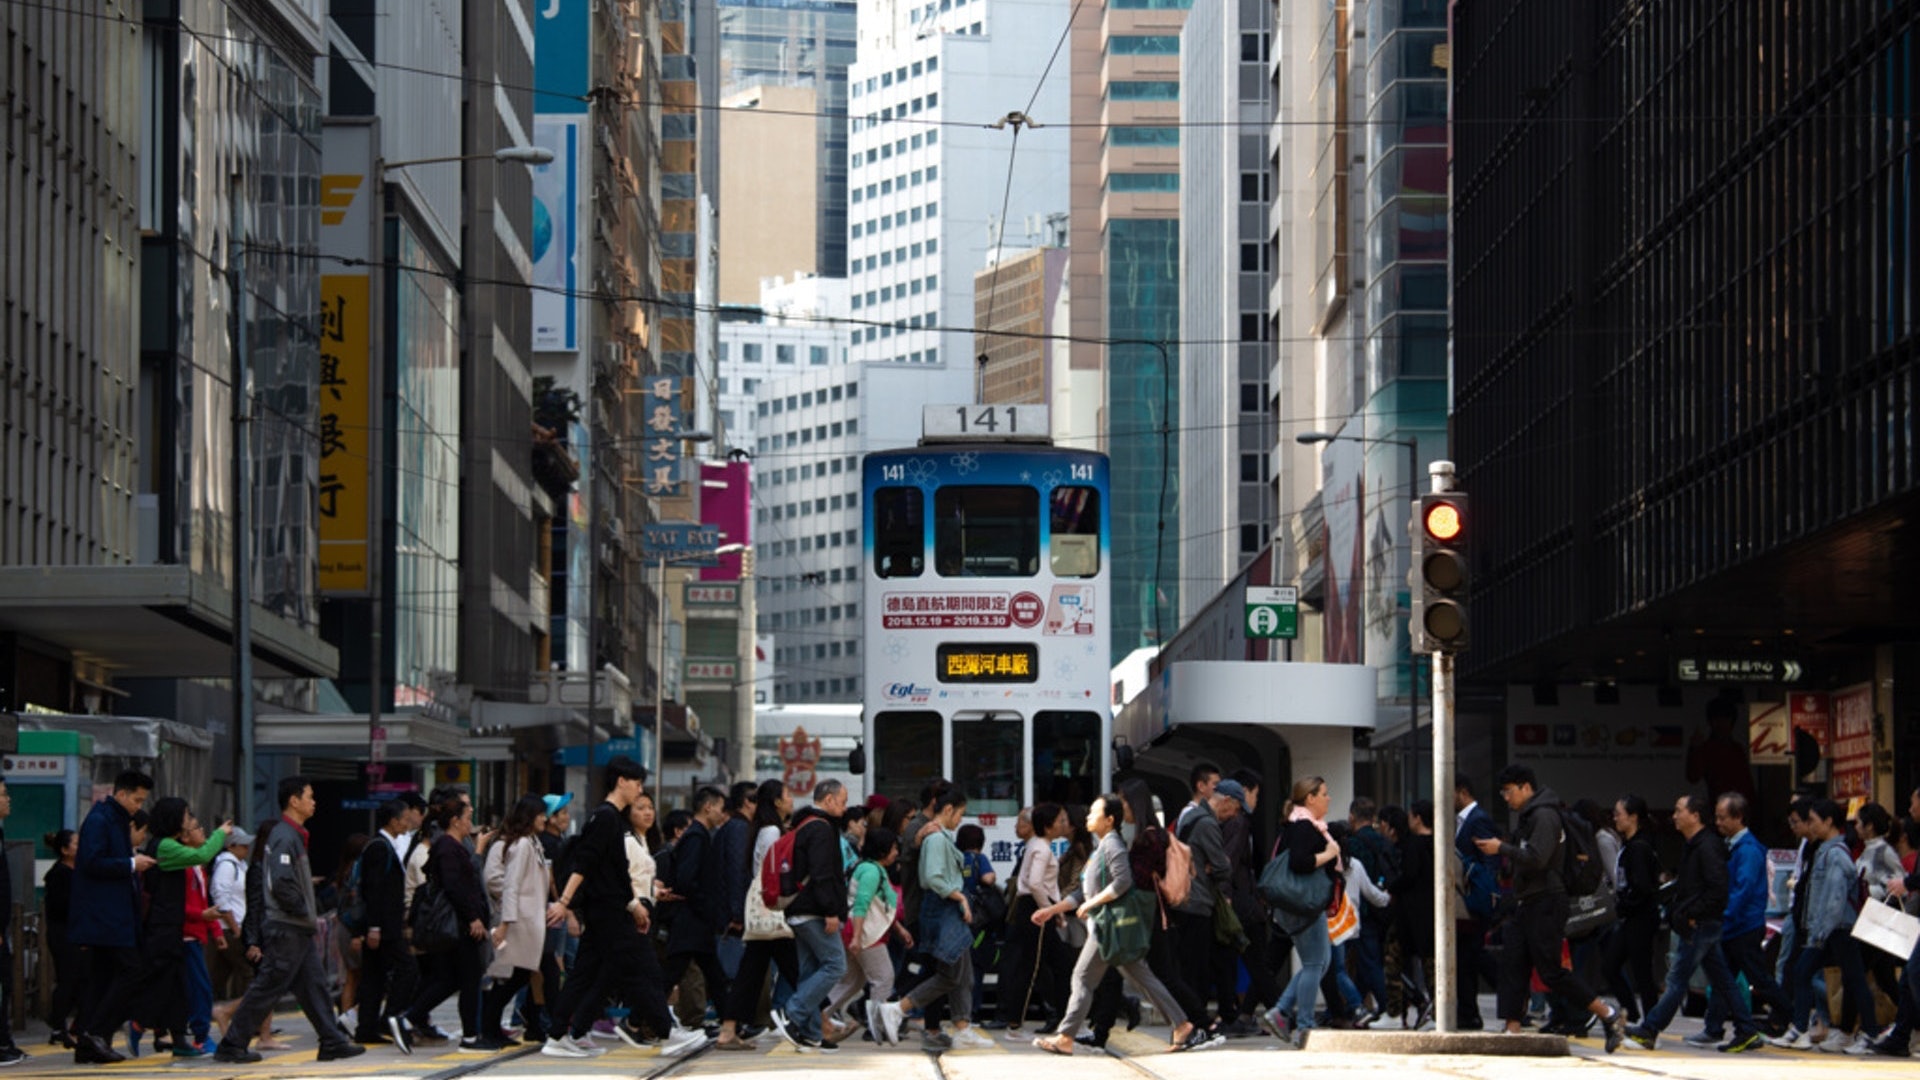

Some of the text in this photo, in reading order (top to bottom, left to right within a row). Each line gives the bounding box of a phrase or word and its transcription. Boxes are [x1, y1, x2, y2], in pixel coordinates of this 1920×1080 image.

[956, 407, 1017, 432] 141
[647, 378, 679, 494] 日發文具
[882, 465, 905, 481] 141
[1070, 464, 1093, 480] 141
[648, 530, 716, 545] YAT FAT
[888, 616, 942, 626] 2018.12.19
[954, 615, 1006, 625] 2019.3.30
[946, 654, 1030, 675] 西灣河車廠
